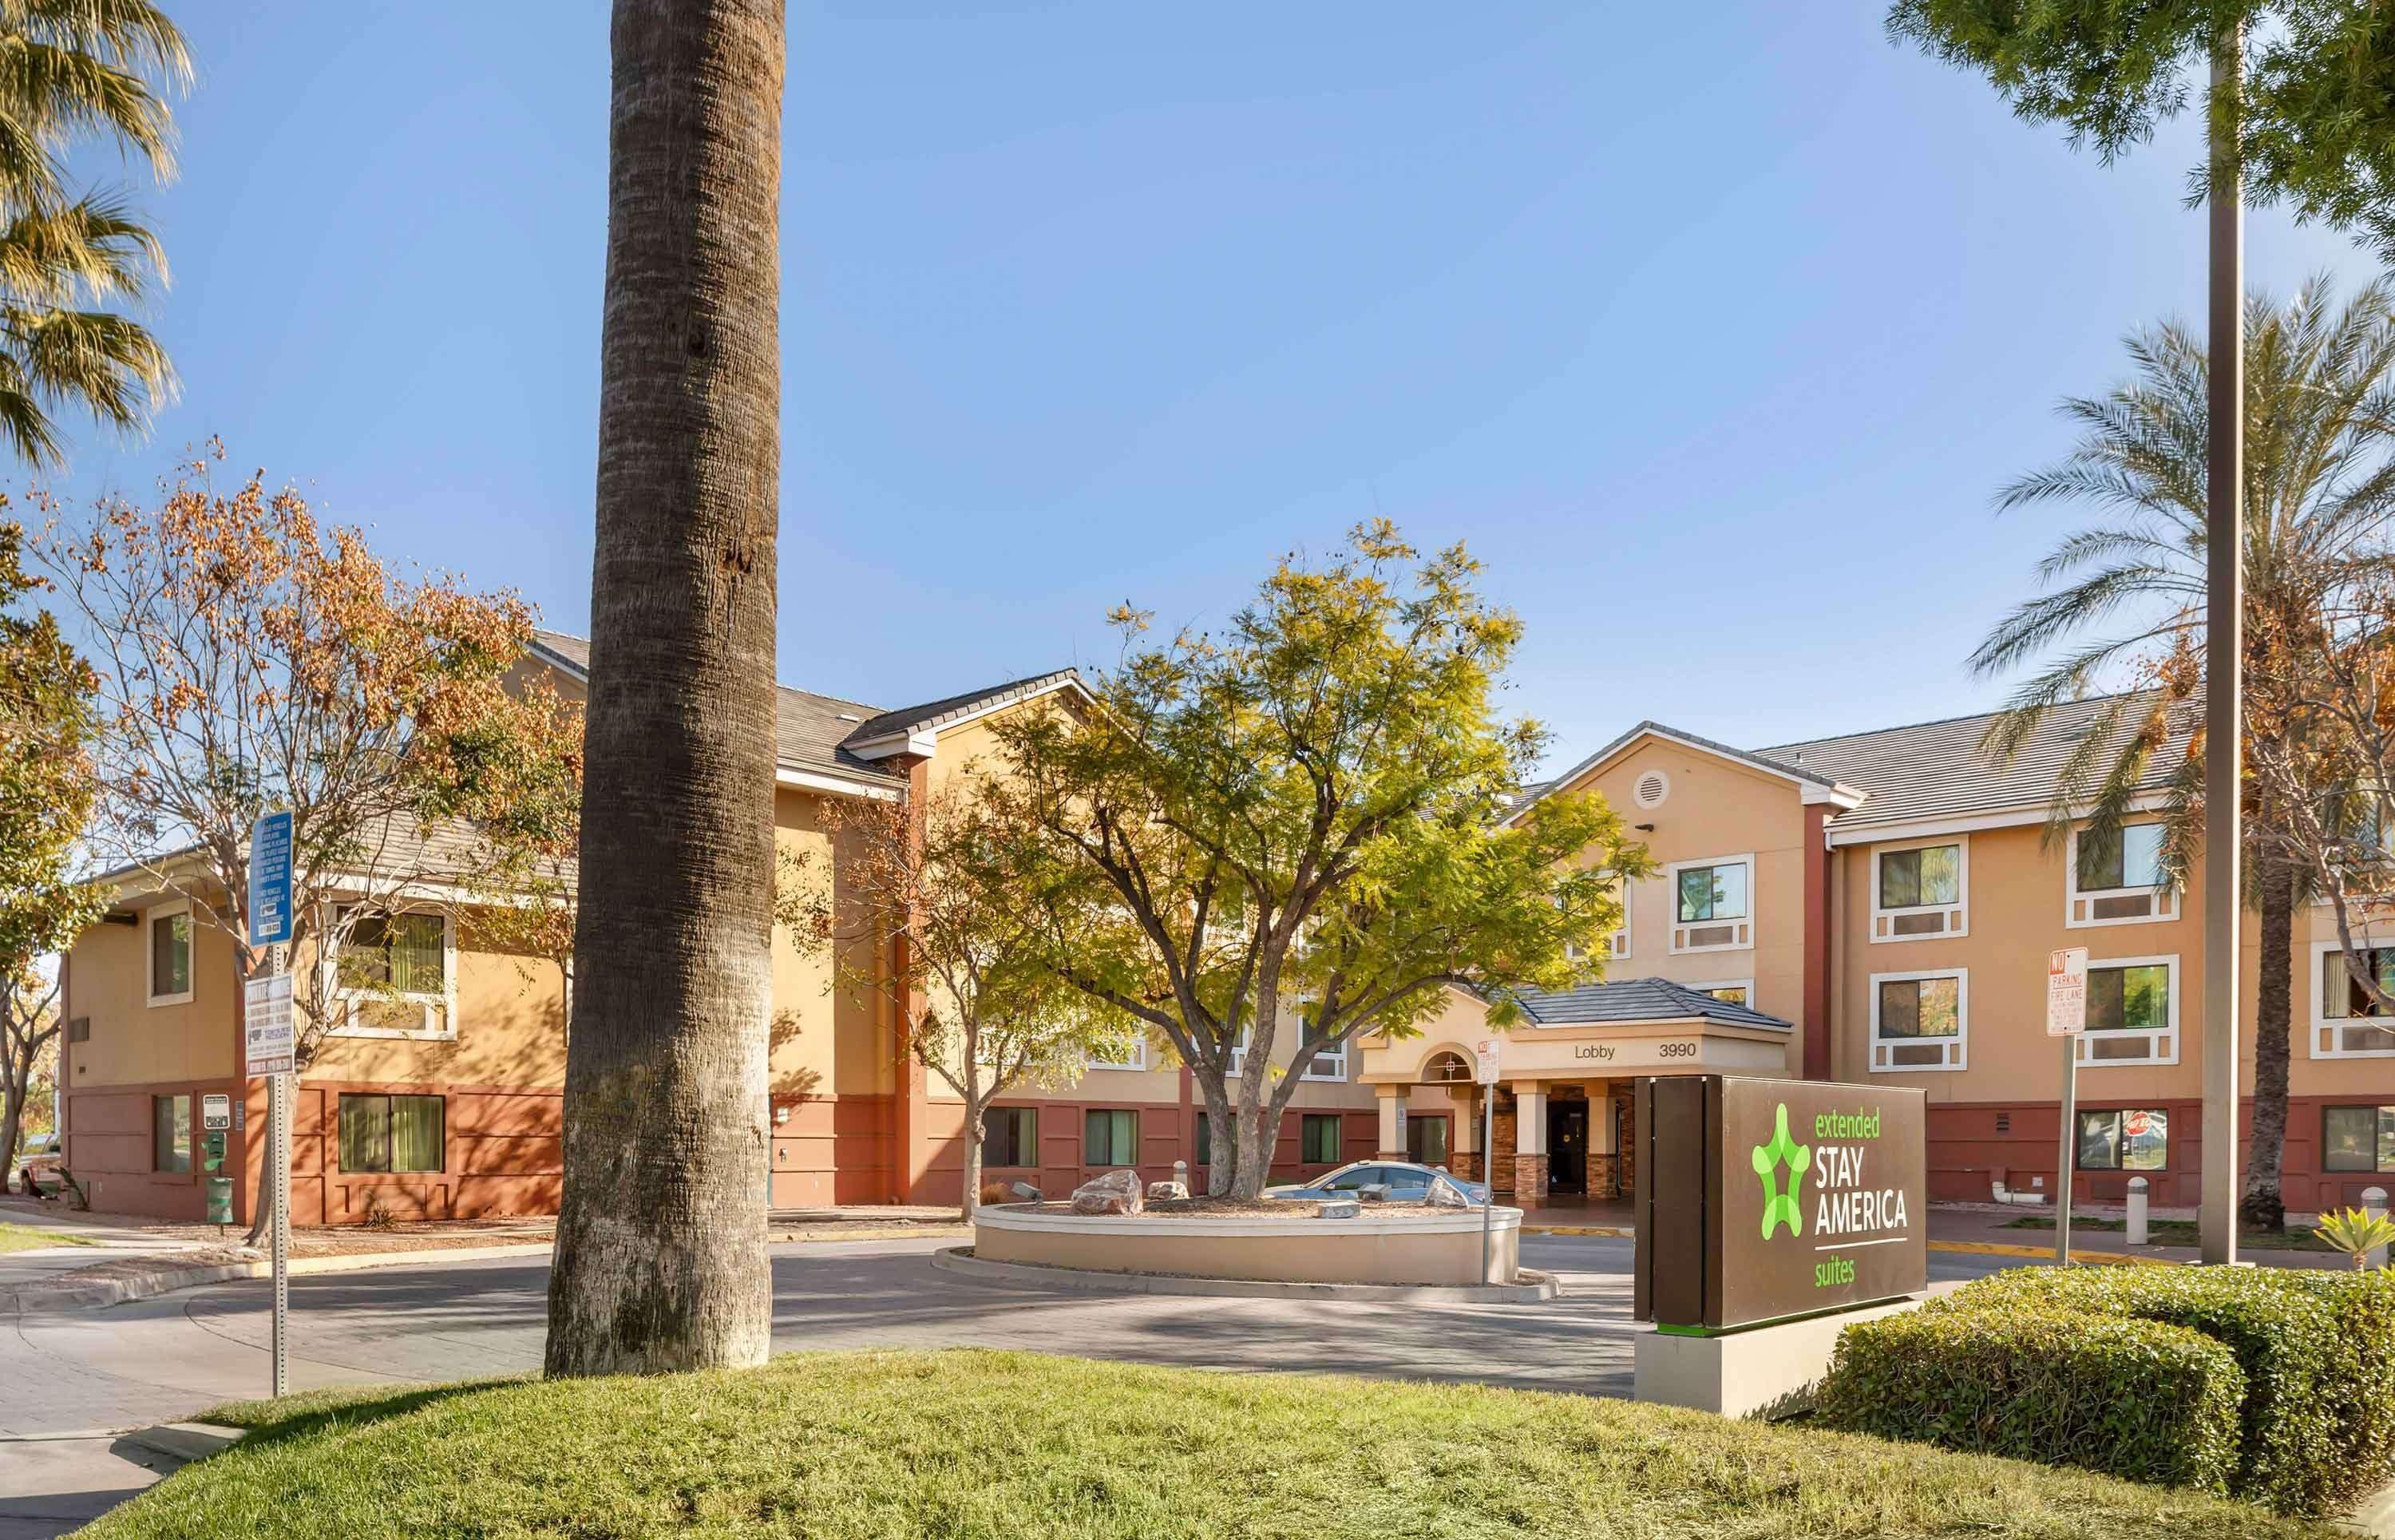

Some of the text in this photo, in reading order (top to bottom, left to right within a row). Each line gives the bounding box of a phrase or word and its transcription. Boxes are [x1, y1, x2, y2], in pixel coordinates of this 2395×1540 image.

[2052, 952, 2064, 972] NO
[2053, 973, 2082, 987] PARKING
[2065, 988, 2083, 1000] LANE
[1575, 1043, 1696, 1060] Lobby 3990
[1815, 1107, 1879, 1138] extended
[1815, 1146, 1864, 1188] STAY
[1815, 1189, 1907, 1235] AMERICA
[1815, 1255, 1855, 1288] suites
